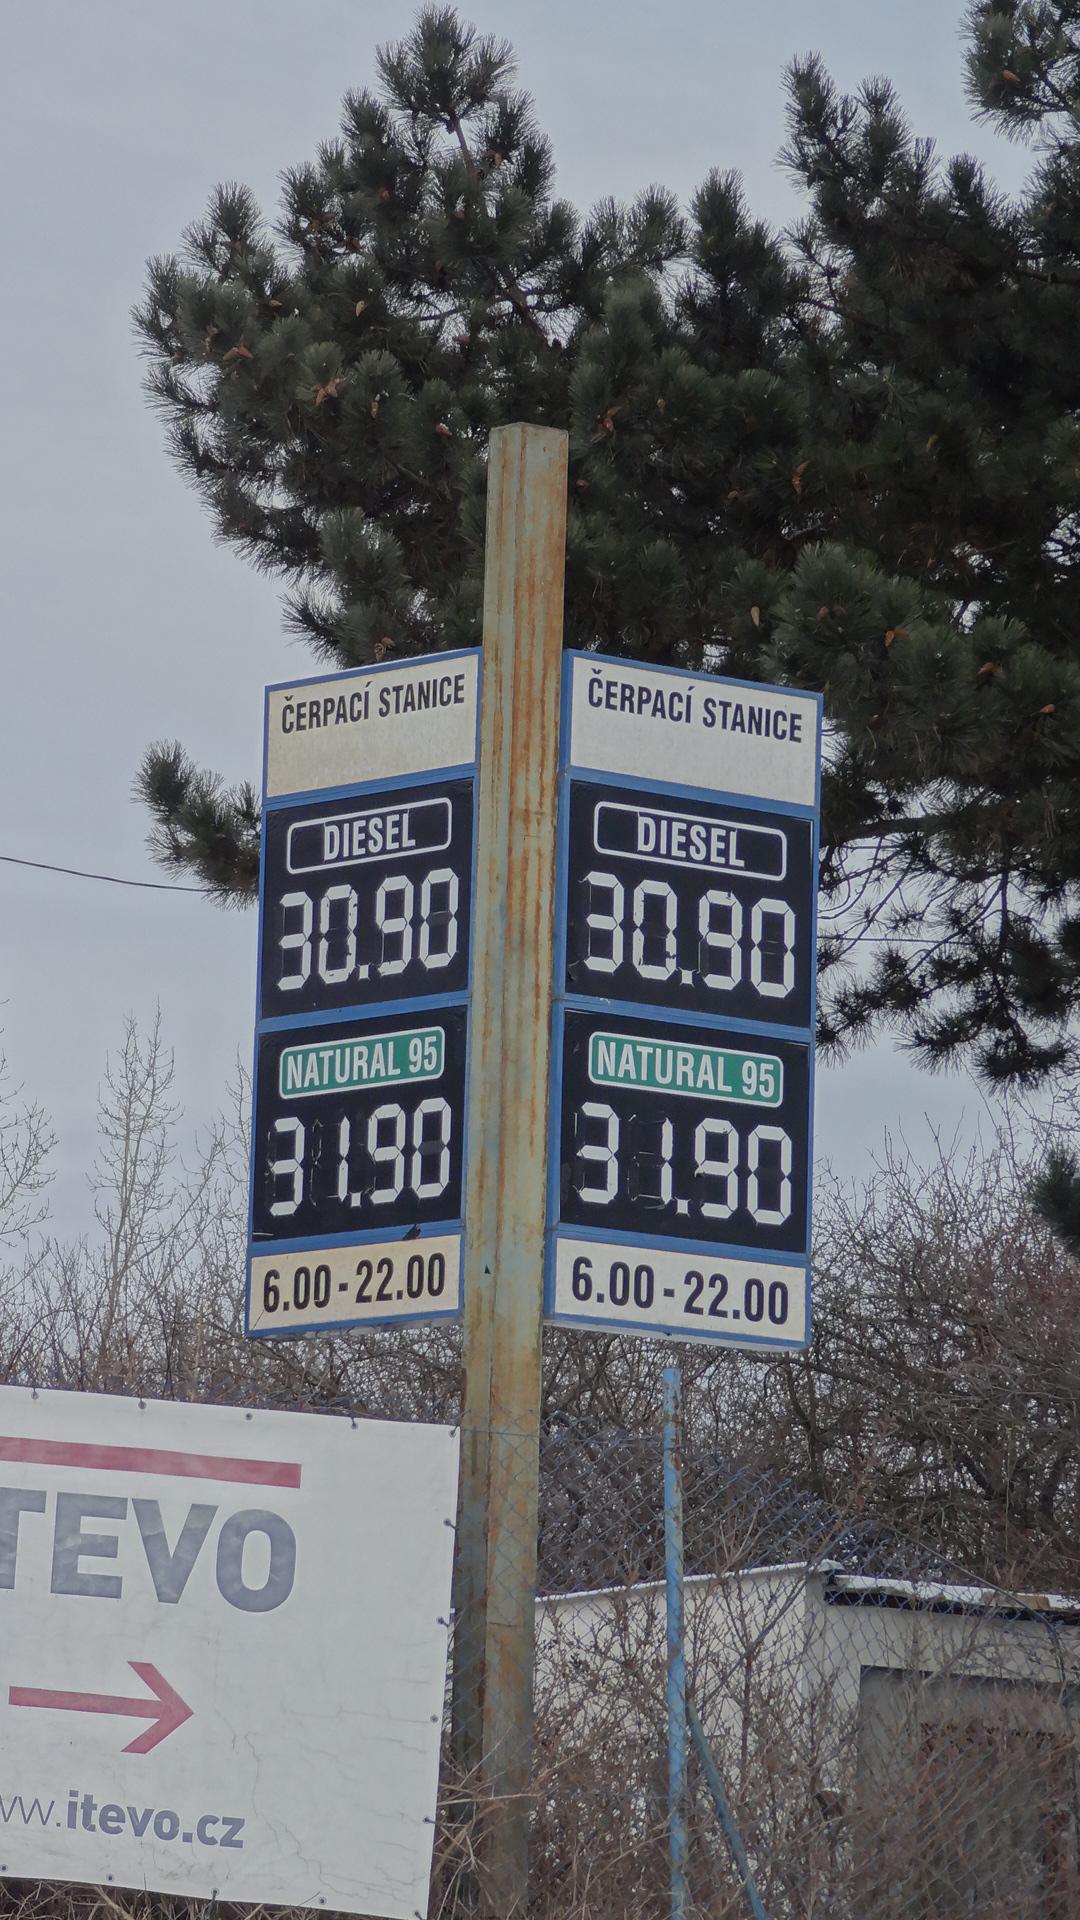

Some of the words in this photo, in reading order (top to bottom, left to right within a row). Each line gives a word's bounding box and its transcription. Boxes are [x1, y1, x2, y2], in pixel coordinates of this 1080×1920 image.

[281, 681, 373, 734] ČERPACÍ
[378, 673, 466, 718] STANICE
[587, 668, 695, 724] ČERPACÍ
[702, 697, 803, 743] STANICE
[322, 810, 416, 862] DIESEL
[637, 813, 745, 868] DIESEL
[278, 868, 459, 991] 30.90
[584, 871, 796, 998] 30.90
[286, 1041, 401, 1090] NATURAL
[408, 1036, 438, 1074] 95
[597, 1040, 733, 1092] NATURAL
[741, 1060, 775, 1098] 95
[269, 1097, 452, 1217] 31.90
[577, 1102, 792, 1226] 31.90
